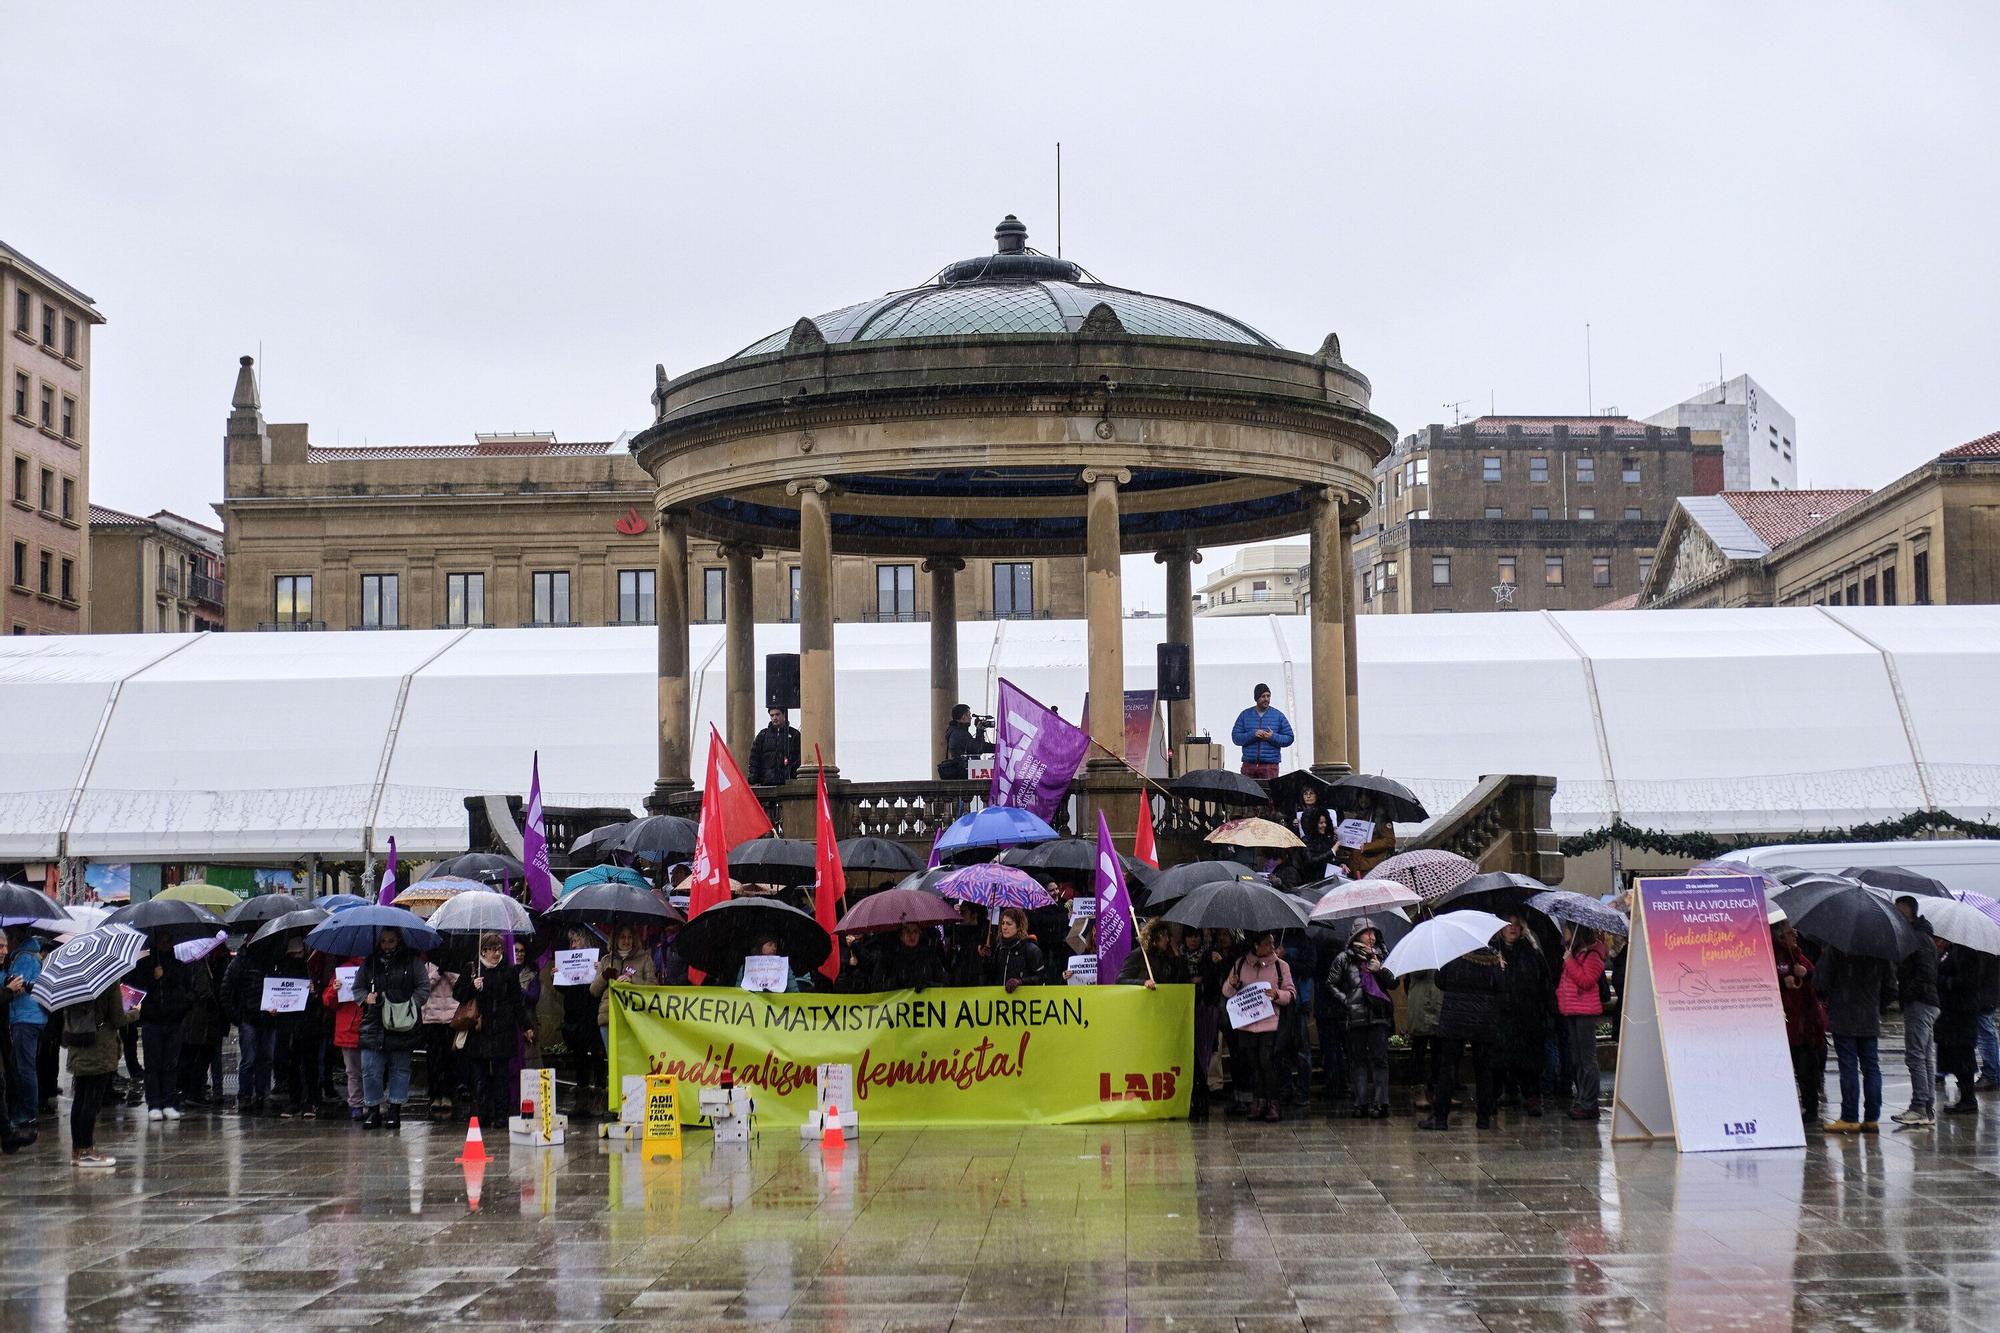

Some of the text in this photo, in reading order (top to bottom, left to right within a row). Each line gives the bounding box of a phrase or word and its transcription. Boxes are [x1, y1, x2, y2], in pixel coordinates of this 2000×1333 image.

[1652, 898, 1759, 911] FRENTE A LA VIOLENCIA
[1702, 938, 1756, 968] feminista!
[610, 986, 1090, 1032] NDARKERIA MATXISTAREN AURREAN,
[857, 1030, 1031, 1100] feminista!
[1099, 1066, 1181, 1102] LAB
[1724, 1119, 1757, 1136] LAB
